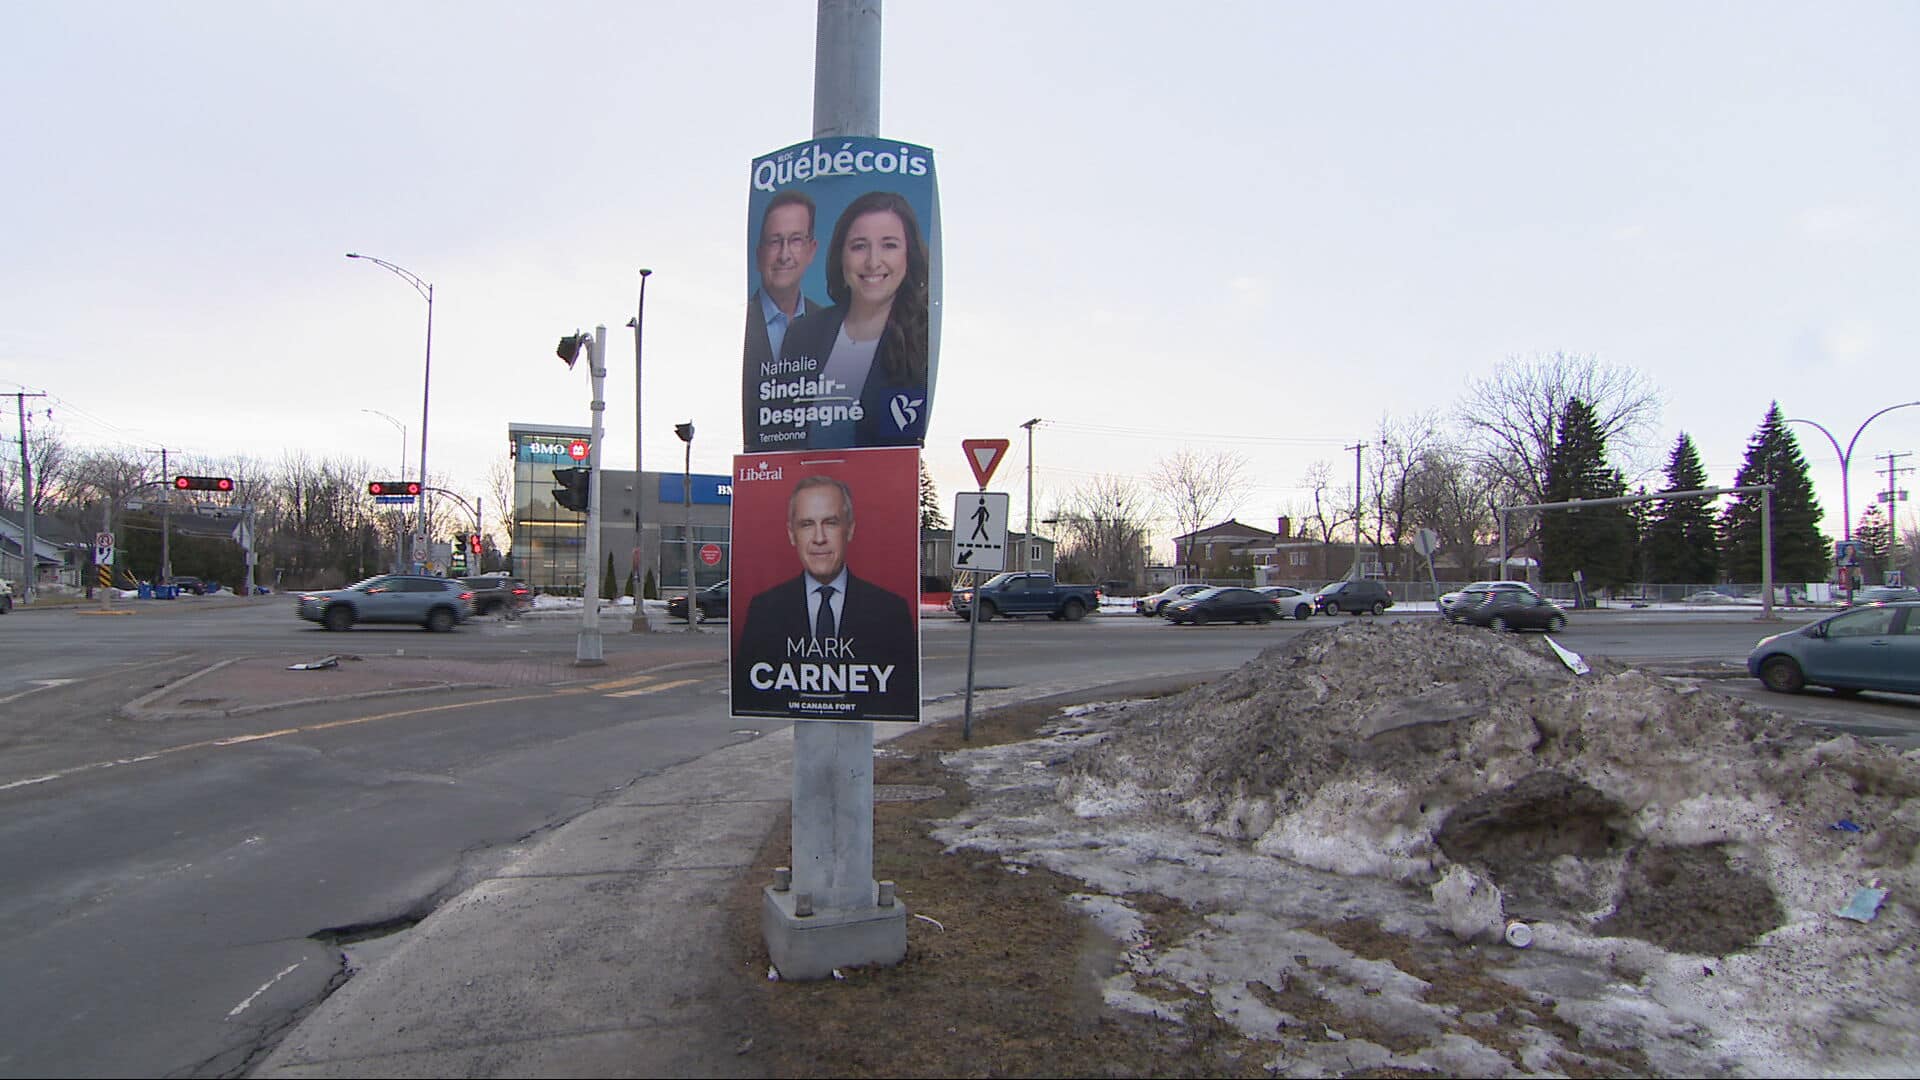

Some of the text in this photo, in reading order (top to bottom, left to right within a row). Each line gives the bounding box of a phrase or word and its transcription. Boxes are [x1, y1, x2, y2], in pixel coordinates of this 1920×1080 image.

[754, 143, 928, 192] Québécois
[760, 356, 817, 376] Nathalie
[759, 374, 846, 401] Sinclair-
[759, 400, 864, 428] Desgagné
[759, 431, 807, 443] Terrebonne
[530, 443, 565, 455] BMO
[786, 636, 855, 659] MARK
[750, 661, 895, 693] CARNEY
[788, 701, 856, 711] UN CANADA FORT
